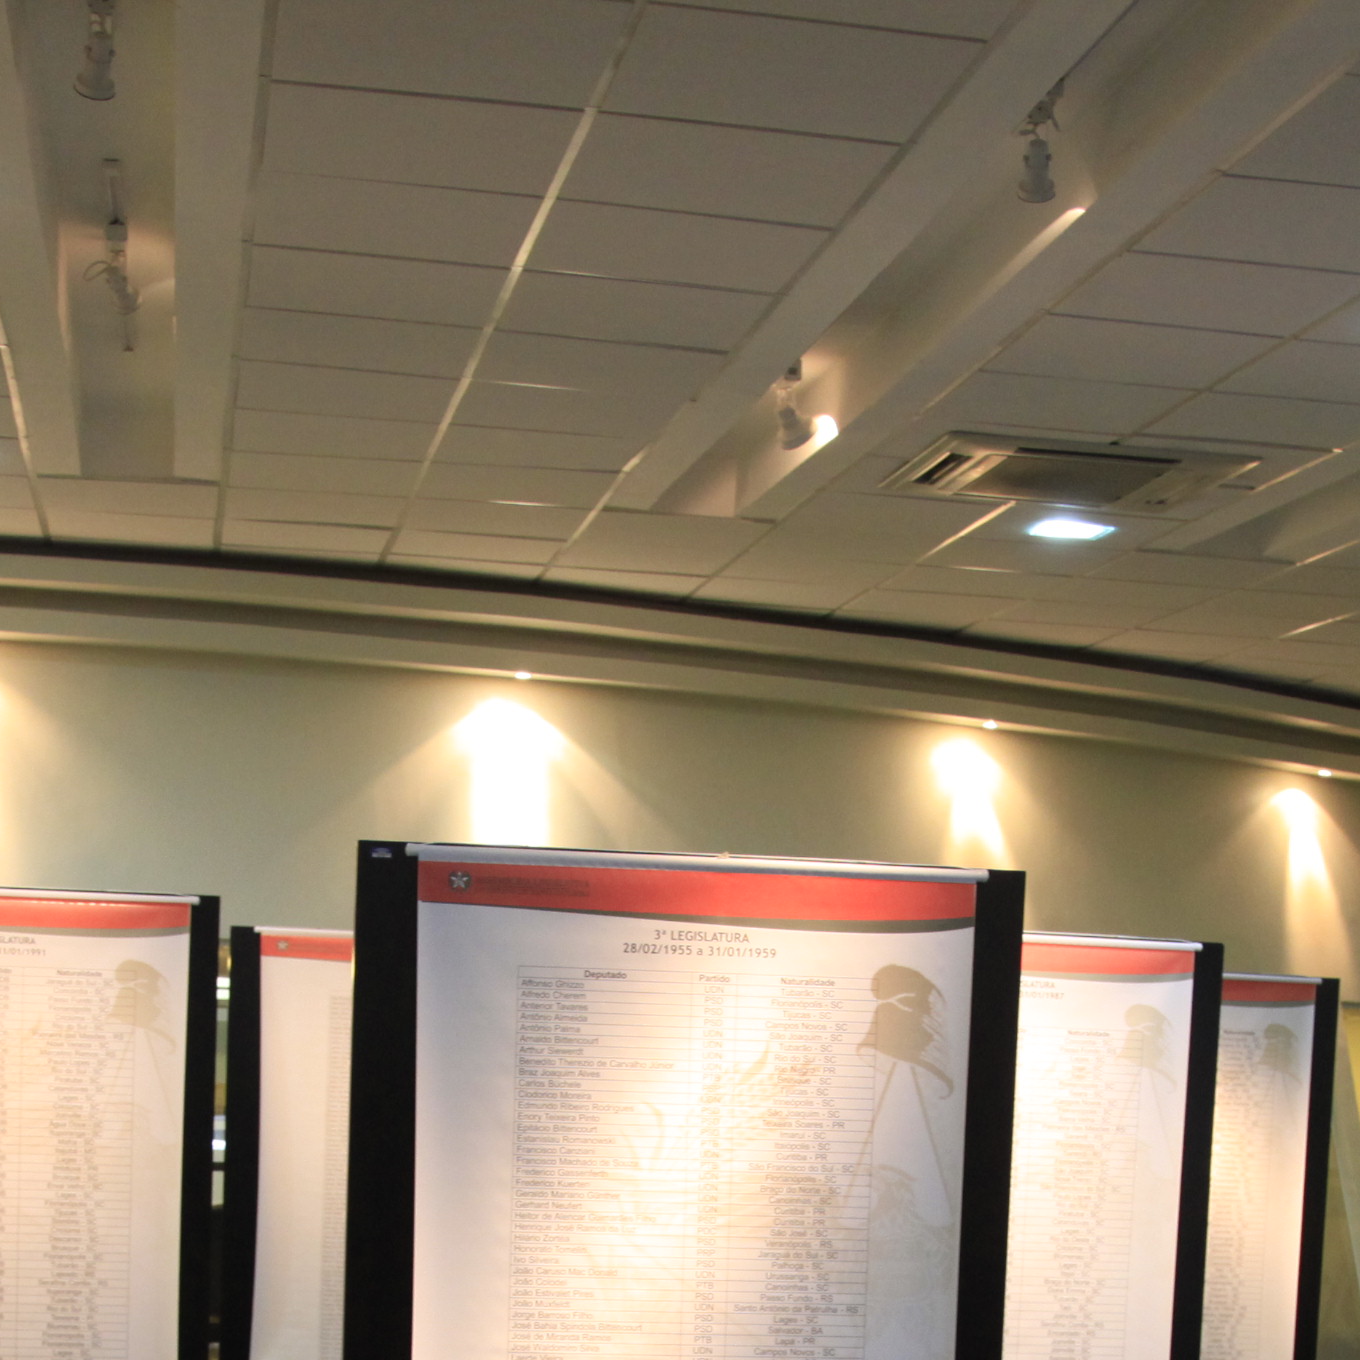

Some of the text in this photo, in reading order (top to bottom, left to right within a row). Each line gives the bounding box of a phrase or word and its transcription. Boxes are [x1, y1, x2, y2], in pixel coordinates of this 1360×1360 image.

[670, 931, 750, 943] LEGISLATURA
[623, 943, 777, 958] 28/02/1955 a 31/01/1959
[583, 969, 627, 981] Deputado
[698, 973, 731, 982] Partido
[779, 976, 835, 986] Naturalidade
[703, 985, 724, 993] UDN
[520, 990, 550, 999] Alfredo
[703, 996, 723, 1004] PSD
[770, 998, 823, 1009] Florianópolis
[829, 1000, 843, 1008] SC
[554, 1002, 588, 1011] Tavares
[703, 1007, 723, 1015] PSD
[519, 1012, 588, 1022] Antônio Almeida
[781, 1009, 811, 1020] Tijucas
[817, 1011, 831, 1019] SC
[703, 1018, 723, 1026] PSD
[519, 1023, 580, 1033] Antônio Palma
[702, 1029, 723, 1037] UDN
[518, 1034, 598, 1045] Arnaldo Bittencourt
[701, 1040, 723, 1048] UDN
[518, 1045, 545, 1054] Arthur
[701, 1051, 722, 1059] UDN
[773, 1053, 788, 1061] Rio
[789, 1054, 800, 1062] do
[801, 1054, 816, 1062] Sul
[822, 1055, 836, 1063] SC
[518, 1056, 556, 1065] Benedito
[595, 1059, 607, 1067] de
[608, 1059, 646, 1068] Carvalho
[647, 1060, 673, 1069] Júnior
[701, 1062, 722, 1070] UDN
[518, 1068, 600, 1079] Braz Joaquim Alves
[517, 1079, 545, 1087] Carlos
[517, 1101, 634, 1114] Edmundo Ribeiro Rodrigues
[515, 1156, 638, 1167] Francisco Machado de Souza
[512, 1256, 559, 1264] Ivo Silveira
[512, 1267, 617, 1276] João Caruso Mac Donald
[694, 1270, 715, 1278] UDN
[511, 1311, 592, 1320] Jorge Barroso Filho
[693, 1314, 713, 1322] PSD
[511, 1321, 531, 1329] José
[532, 1322, 557, 1330] Bahia
[597, 1323, 641, 1331] Bittencourt
[510, 1332, 611, 1342] José de Miranda Ramos
